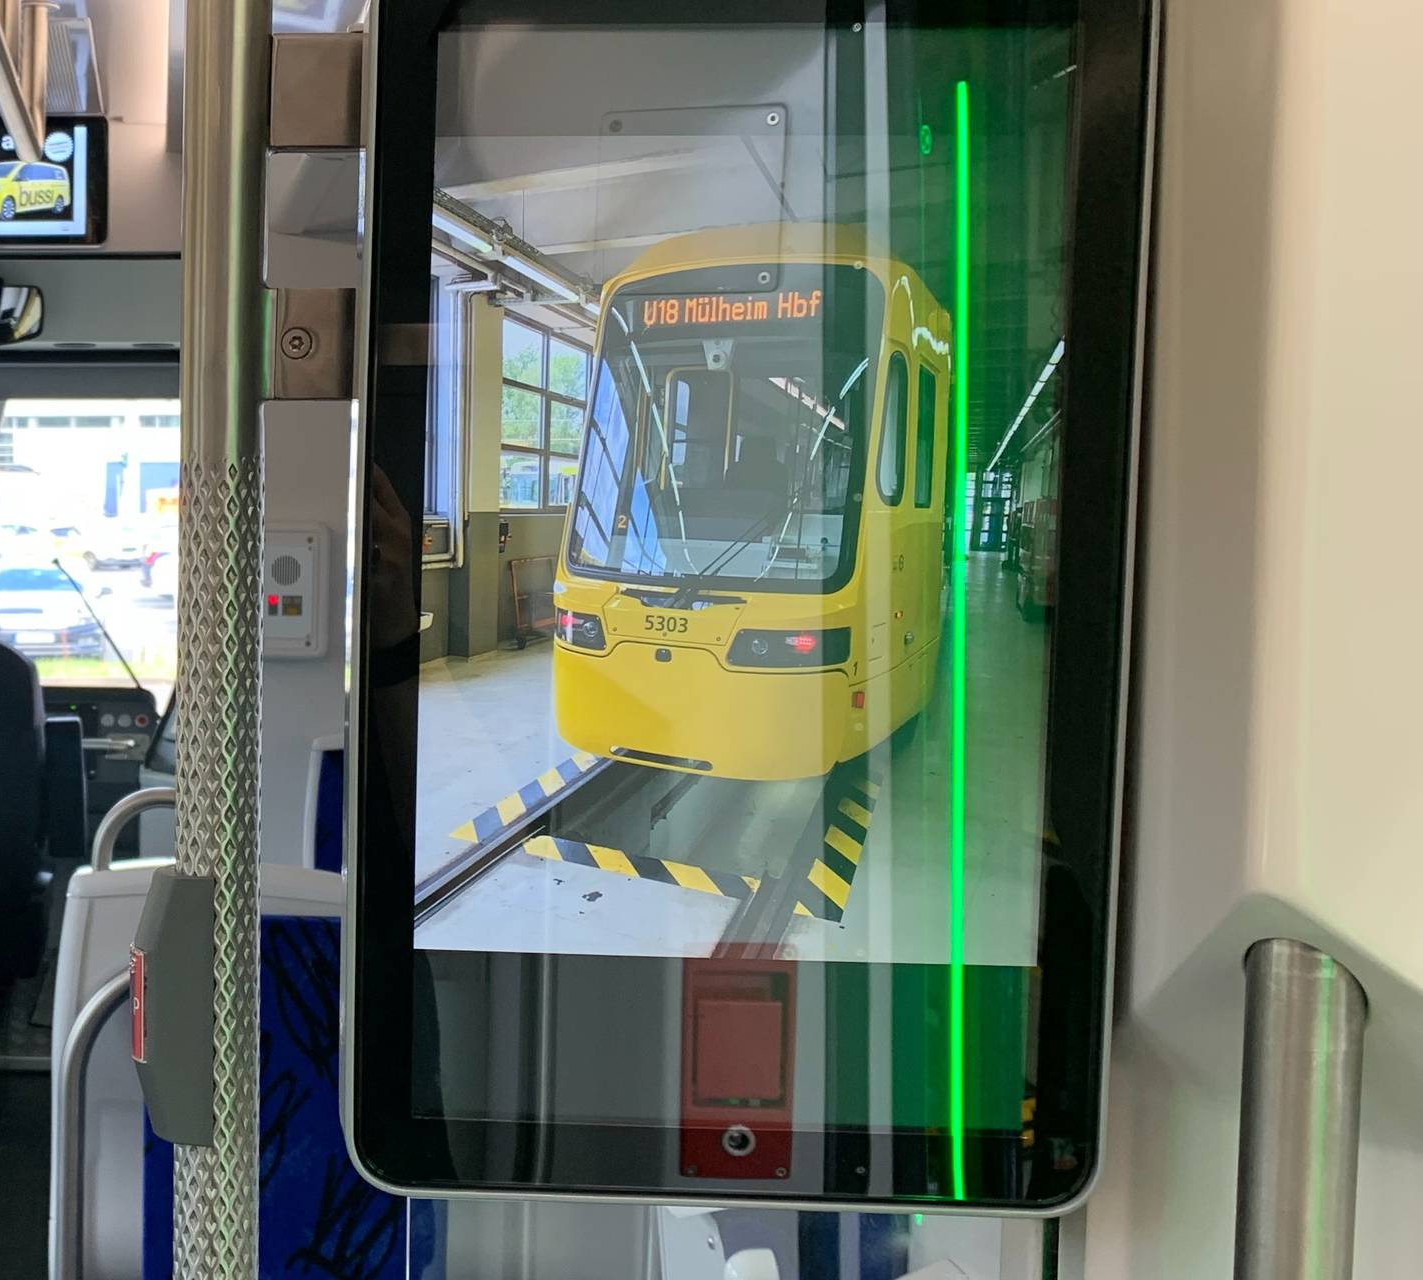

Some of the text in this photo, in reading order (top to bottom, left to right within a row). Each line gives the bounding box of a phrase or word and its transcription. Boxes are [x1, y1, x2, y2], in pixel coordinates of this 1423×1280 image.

[643, 290, 823, 326] U18 Mülheim Hbf
[617, 514, 627, 529] 2
[644, 614, 689, 634] 5303
